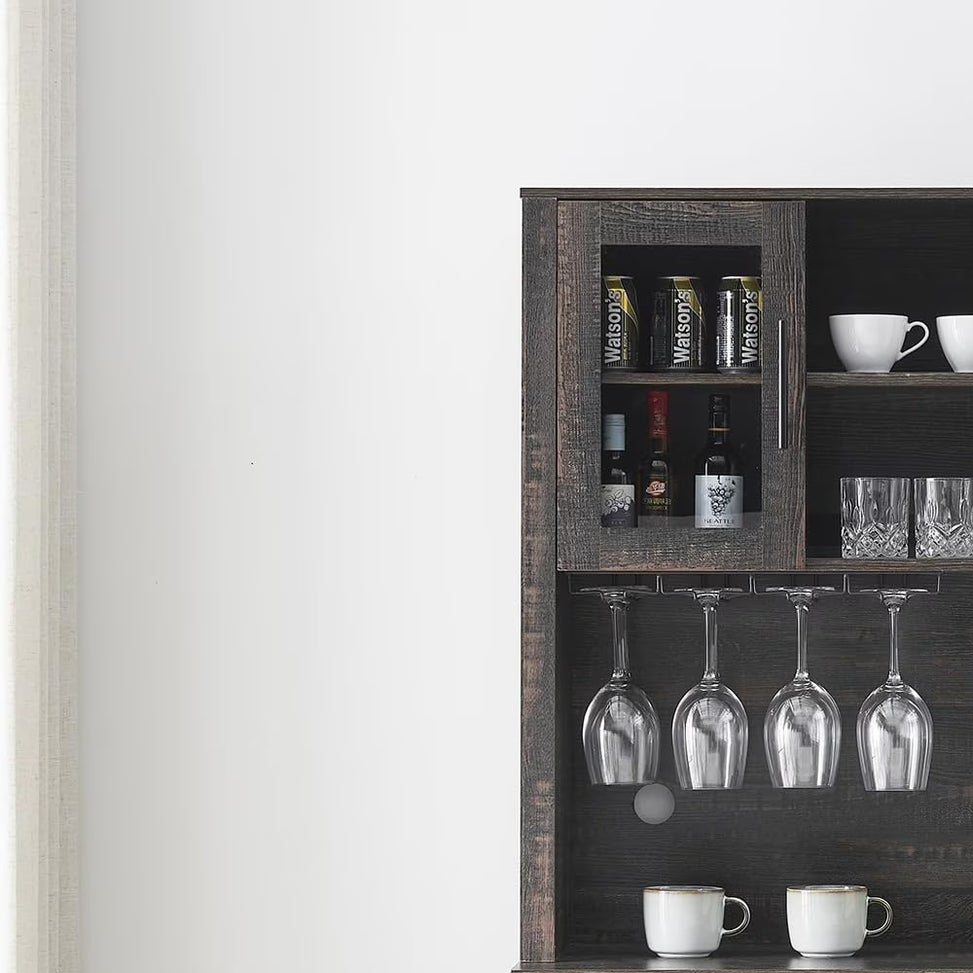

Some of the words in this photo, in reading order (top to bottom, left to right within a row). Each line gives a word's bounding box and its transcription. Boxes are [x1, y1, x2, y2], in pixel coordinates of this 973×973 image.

[604, 291, 622, 364] Watson's
[673, 291, 691, 364] Watson's
[741, 291, 759, 364] Watson's
